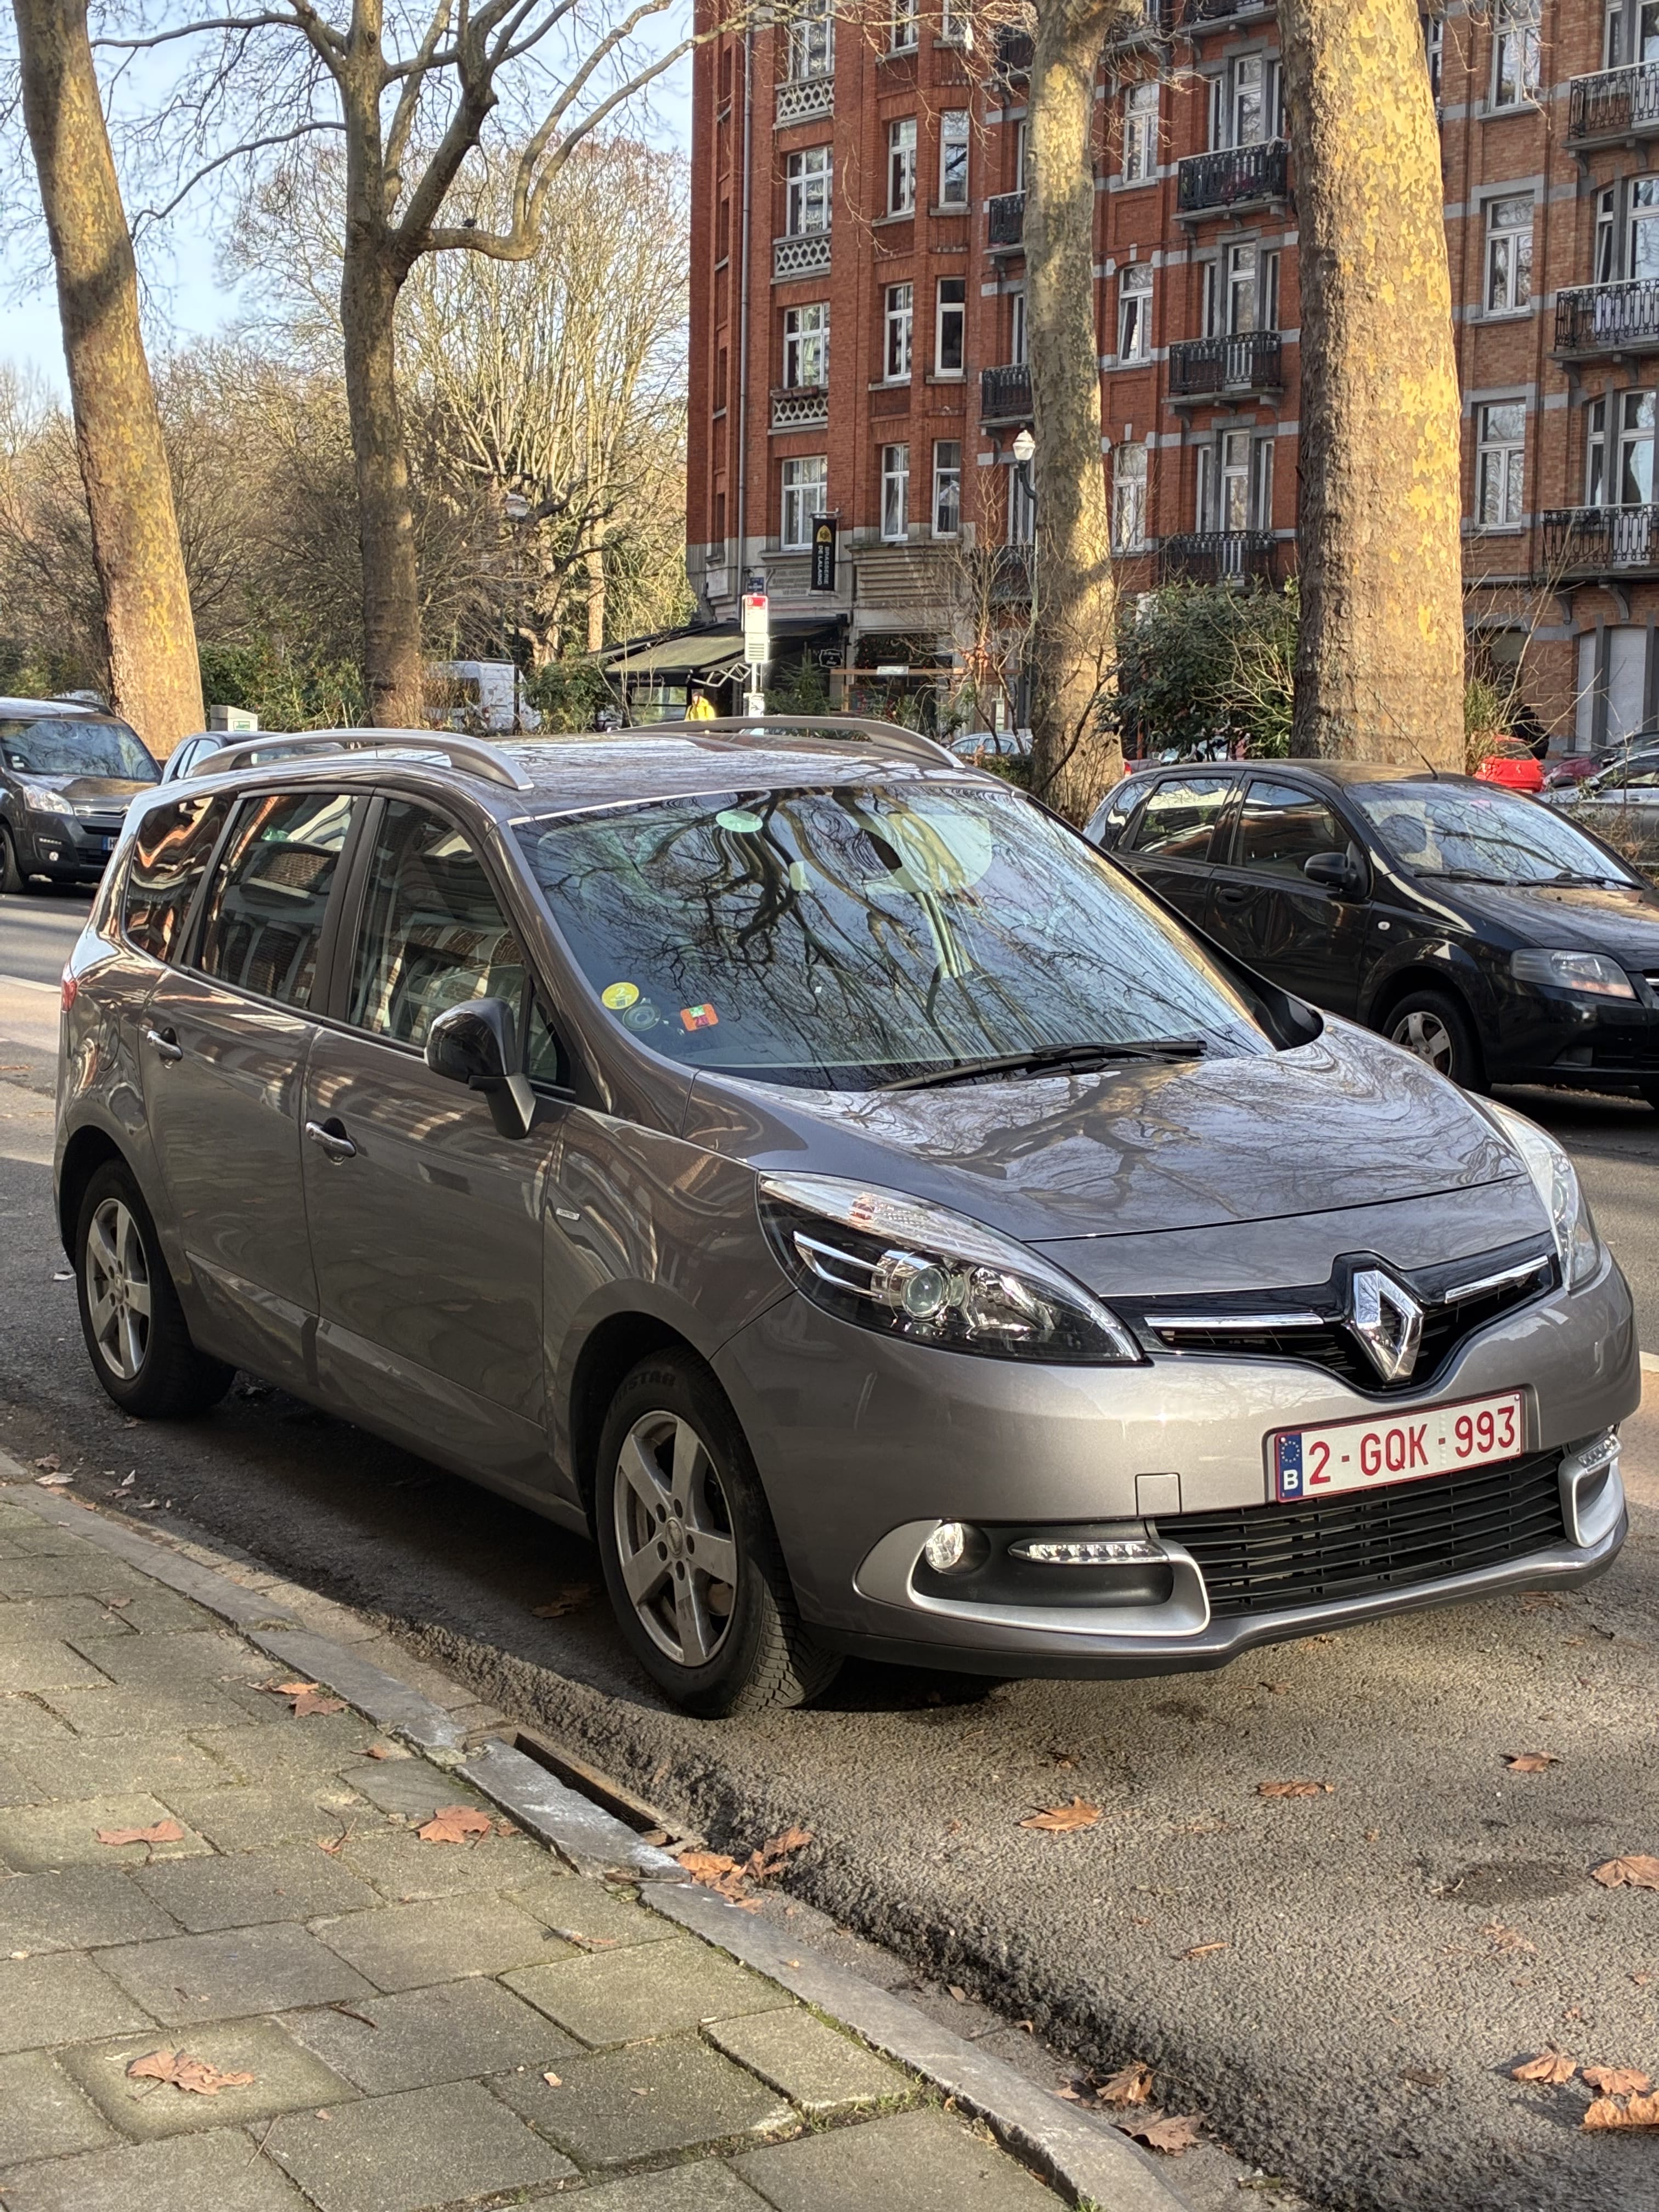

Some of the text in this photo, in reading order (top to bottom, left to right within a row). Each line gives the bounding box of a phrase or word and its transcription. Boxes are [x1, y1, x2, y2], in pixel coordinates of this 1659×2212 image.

[818, 545, 824, 555] DE
[1309, 1406, 1515, 1486] 2-GQK-993
[1283, 1469, 1298, 1490] B
